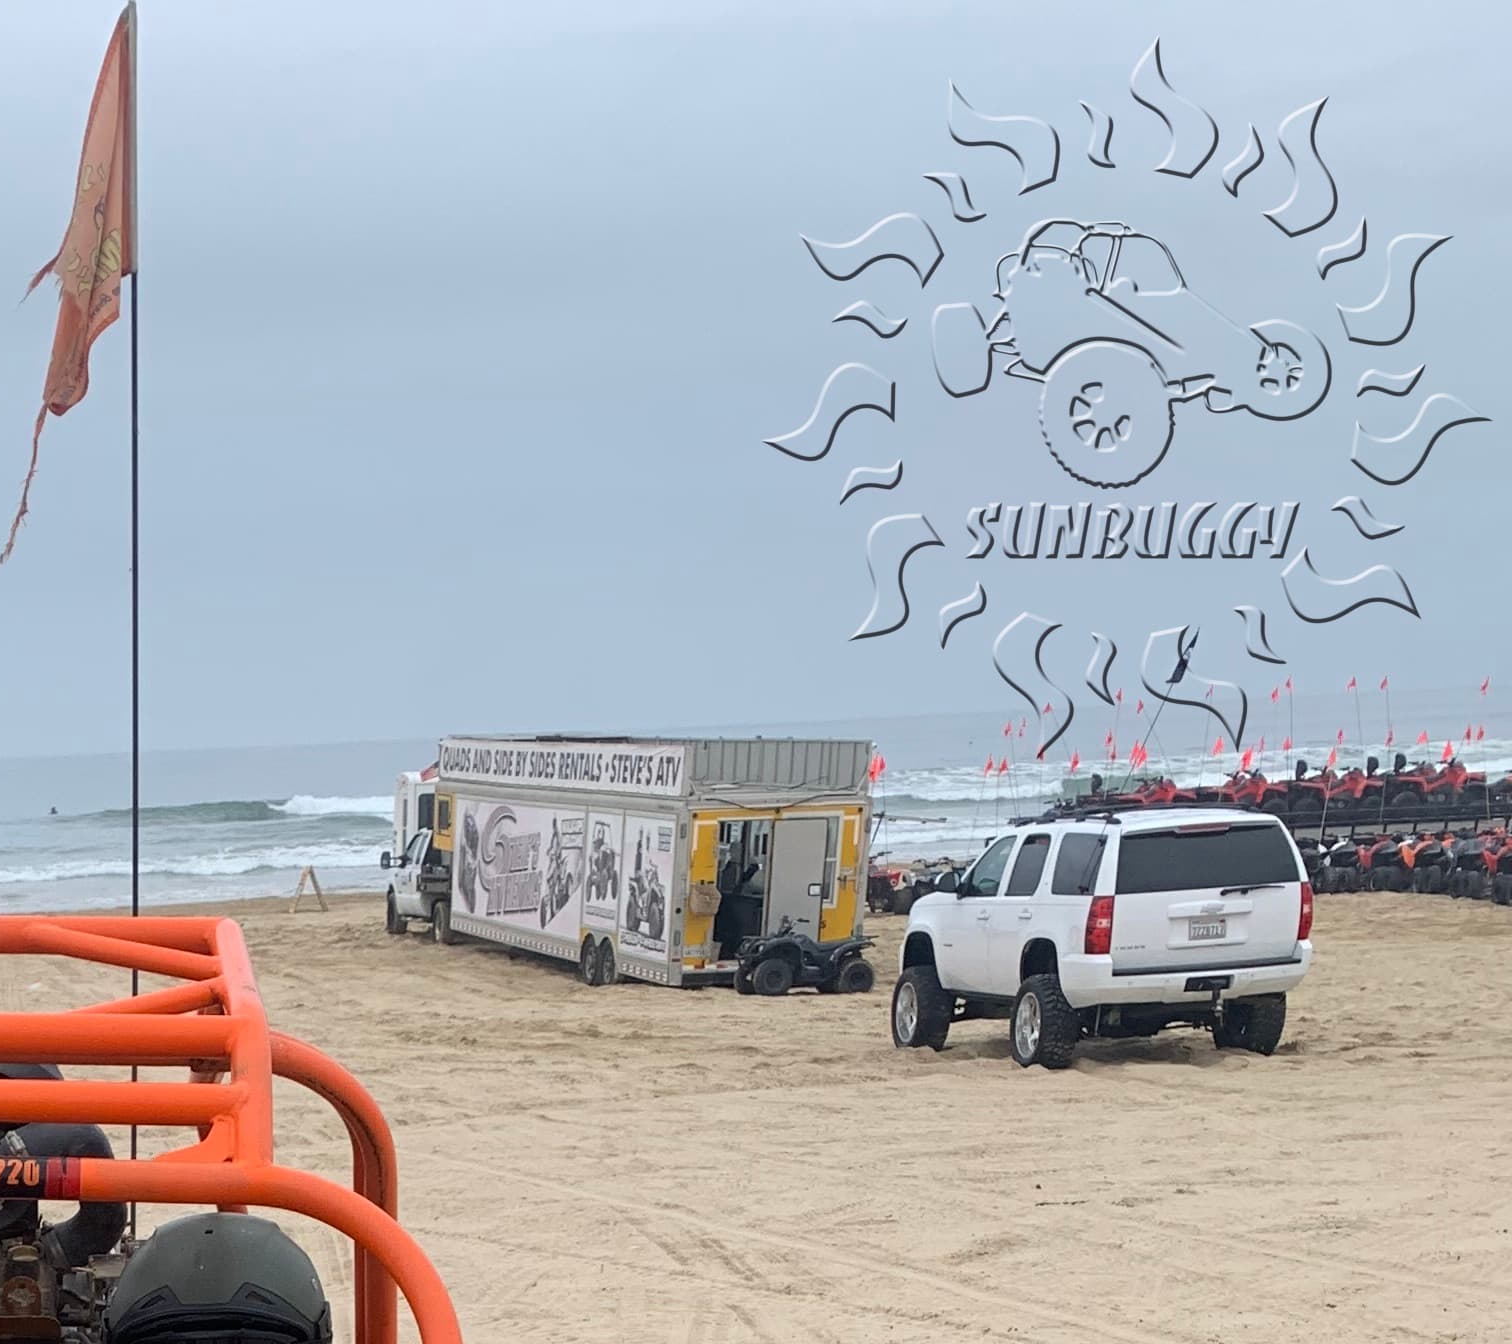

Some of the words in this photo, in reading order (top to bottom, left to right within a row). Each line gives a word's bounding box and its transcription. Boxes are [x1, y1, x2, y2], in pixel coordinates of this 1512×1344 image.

[443, 746, 471, 773] QUADS
[472, 748, 490, 775] AND
[493, 749, 512, 777] SIDE
[514, 750, 528, 778] BY
[529, 751, 556, 780] SIDES
[558, 752, 602, 783] RENTALS
[610, 754, 653, 787] STEVE'S
[655, 756, 681, 788] ATV
